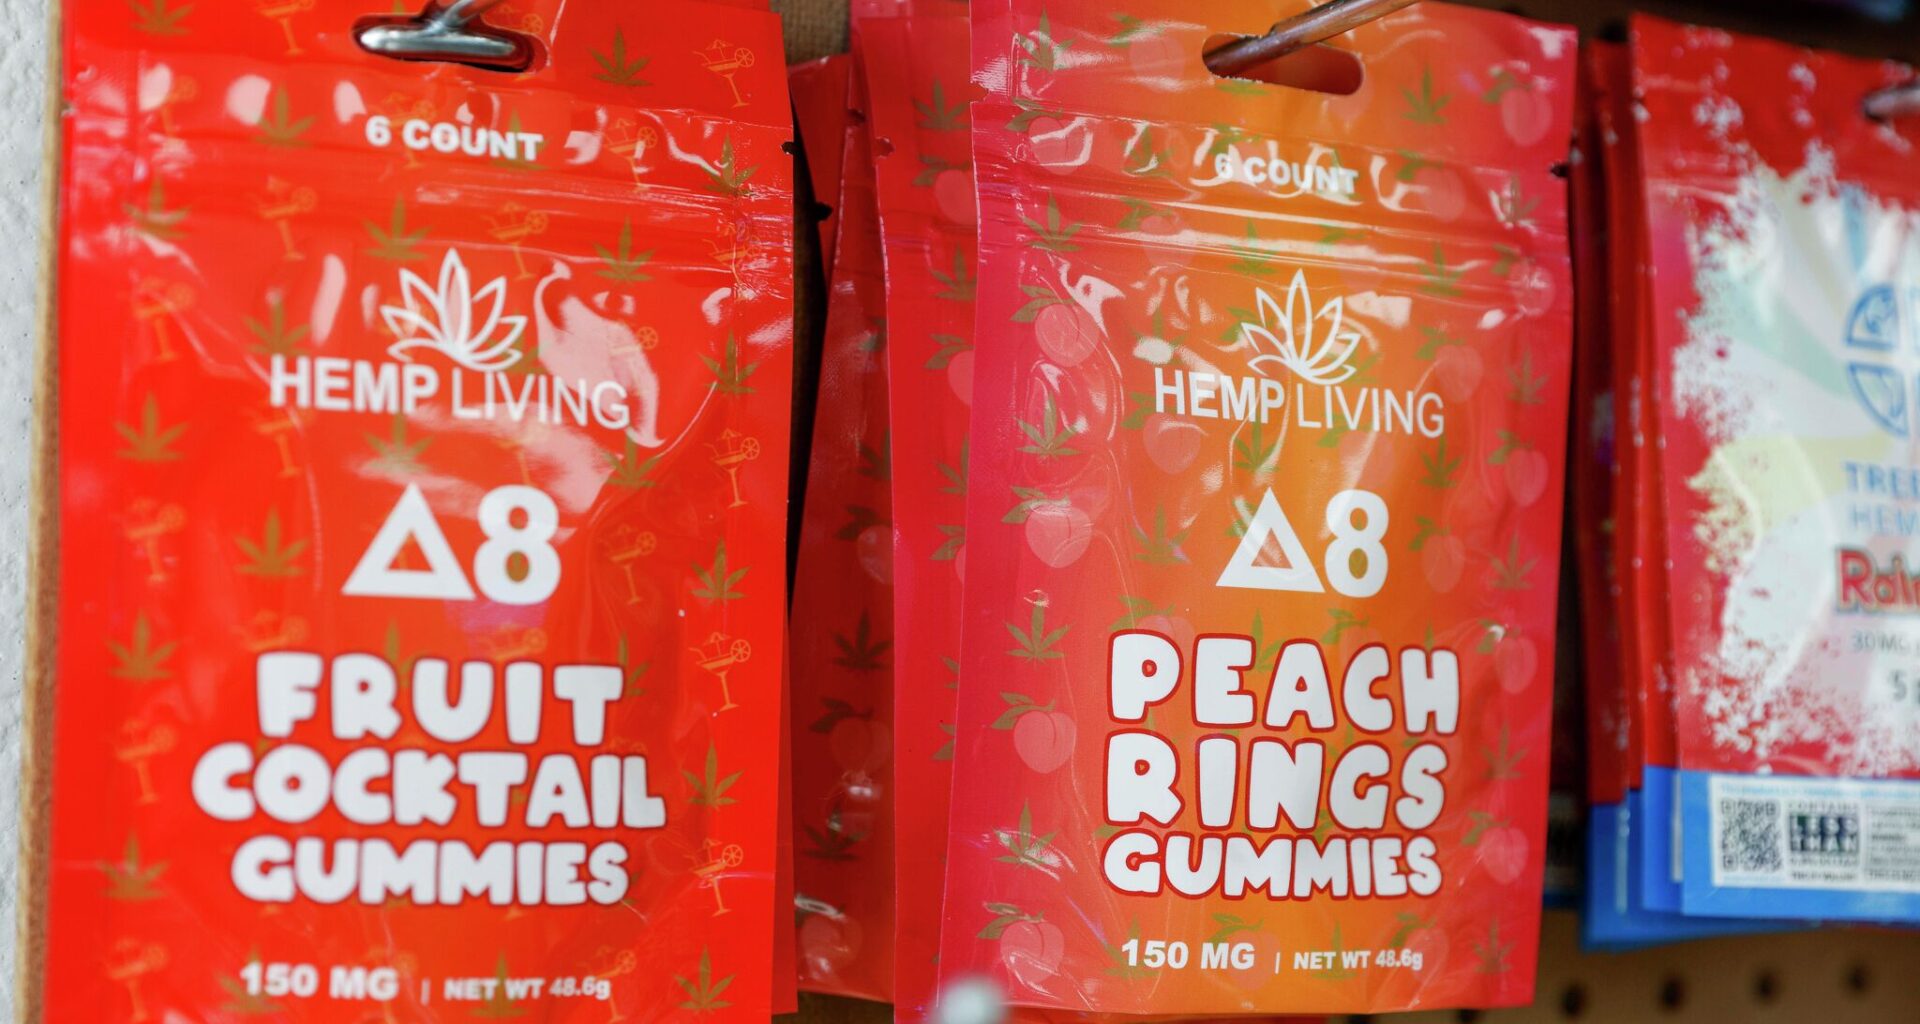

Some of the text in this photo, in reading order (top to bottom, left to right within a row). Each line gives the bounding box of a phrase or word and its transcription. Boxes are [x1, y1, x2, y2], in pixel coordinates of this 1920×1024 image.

[366, 115, 544, 161] 6 COUNT
[1214, 153, 1359, 195] 6 COUNT
[269, 354, 631, 431] HEMP LIVING
[1154, 367, 1445, 439] HEMP LIVING
[256, 651, 625, 746] FRUIT
[1108, 629, 1461, 735] PEACH
[191, 741, 668, 829] COCKTAIL
[1105, 729, 1450, 832] RINGS
[231, 834, 630, 907] GUMMIES
[1101, 830, 1443, 899] GUMMIES
[240, 962, 398, 1001] 150 MG
[444, 975, 611, 1001] NET WT 48.6g
[1121, 939, 1255, 970] 150 MG
[1294, 949, 1424, 971] NET WT 48.6g
